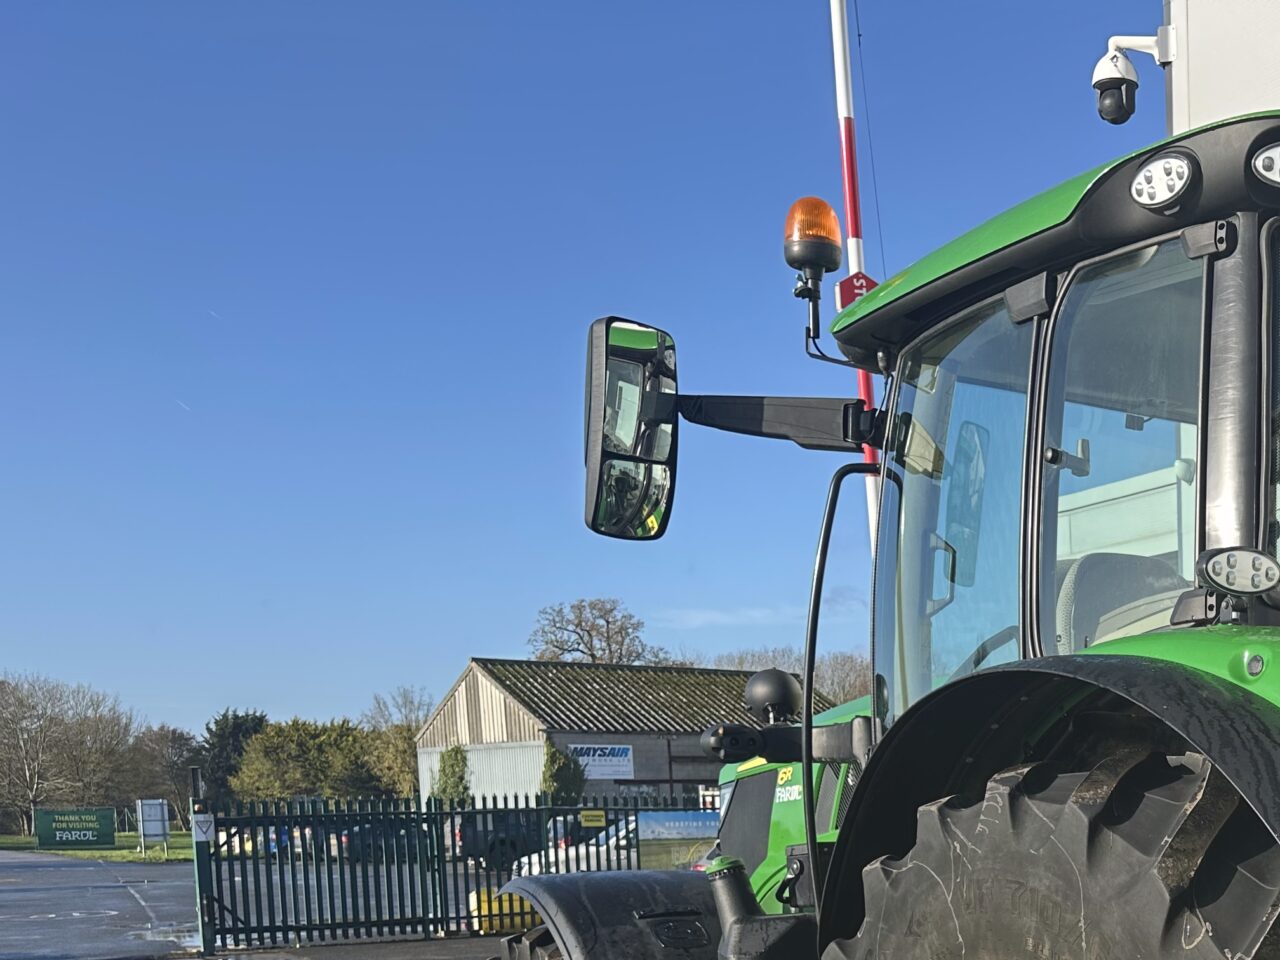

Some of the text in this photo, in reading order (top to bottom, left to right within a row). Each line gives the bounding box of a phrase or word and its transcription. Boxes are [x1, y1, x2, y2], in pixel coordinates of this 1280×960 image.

[571, 746, 630, 758] MAYSAIR
[777, 766, 793, 785] 6R
[55, 830, 97, 841] FAROL
